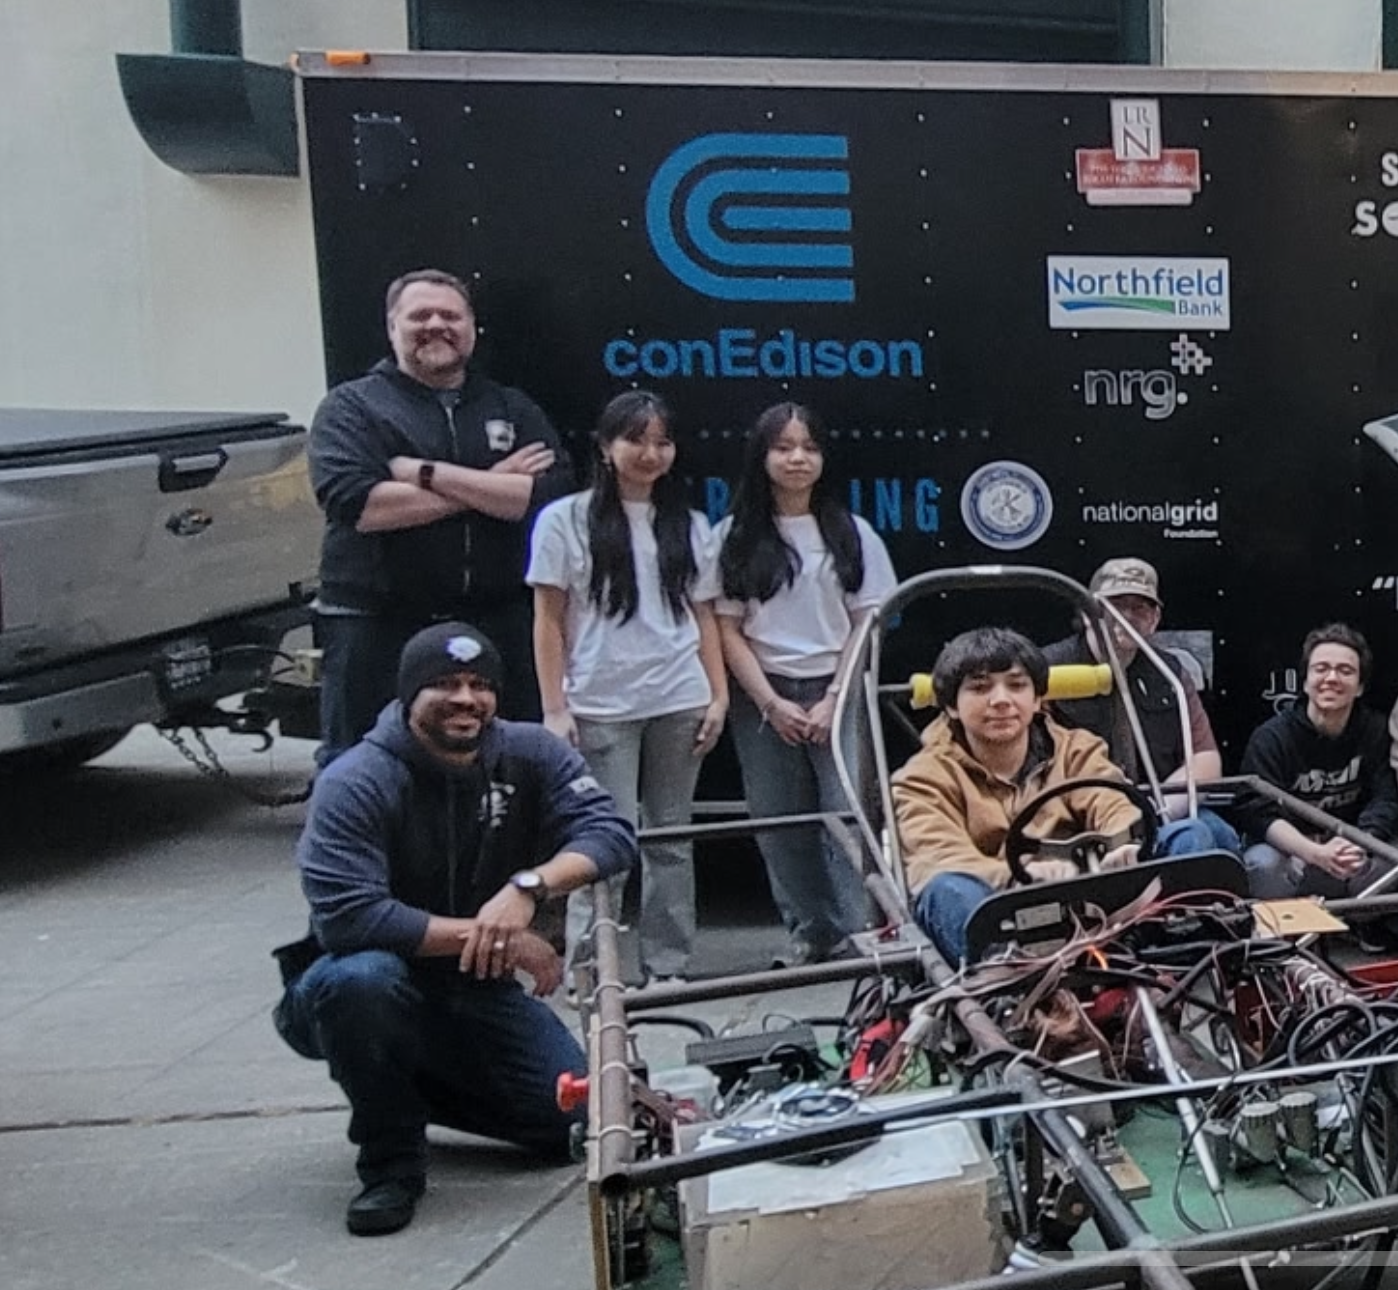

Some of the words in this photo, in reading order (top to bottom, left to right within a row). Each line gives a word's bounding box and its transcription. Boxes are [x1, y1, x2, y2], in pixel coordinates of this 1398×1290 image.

[1123, 126, 1151, 157] N
[1053, 268, 1223, 296] Northfield
[1178, 300, 1223, 317] Bank
[603, 329, 924, 379] conEdison
[1083, 499, 1218, 526] nationalgrid
